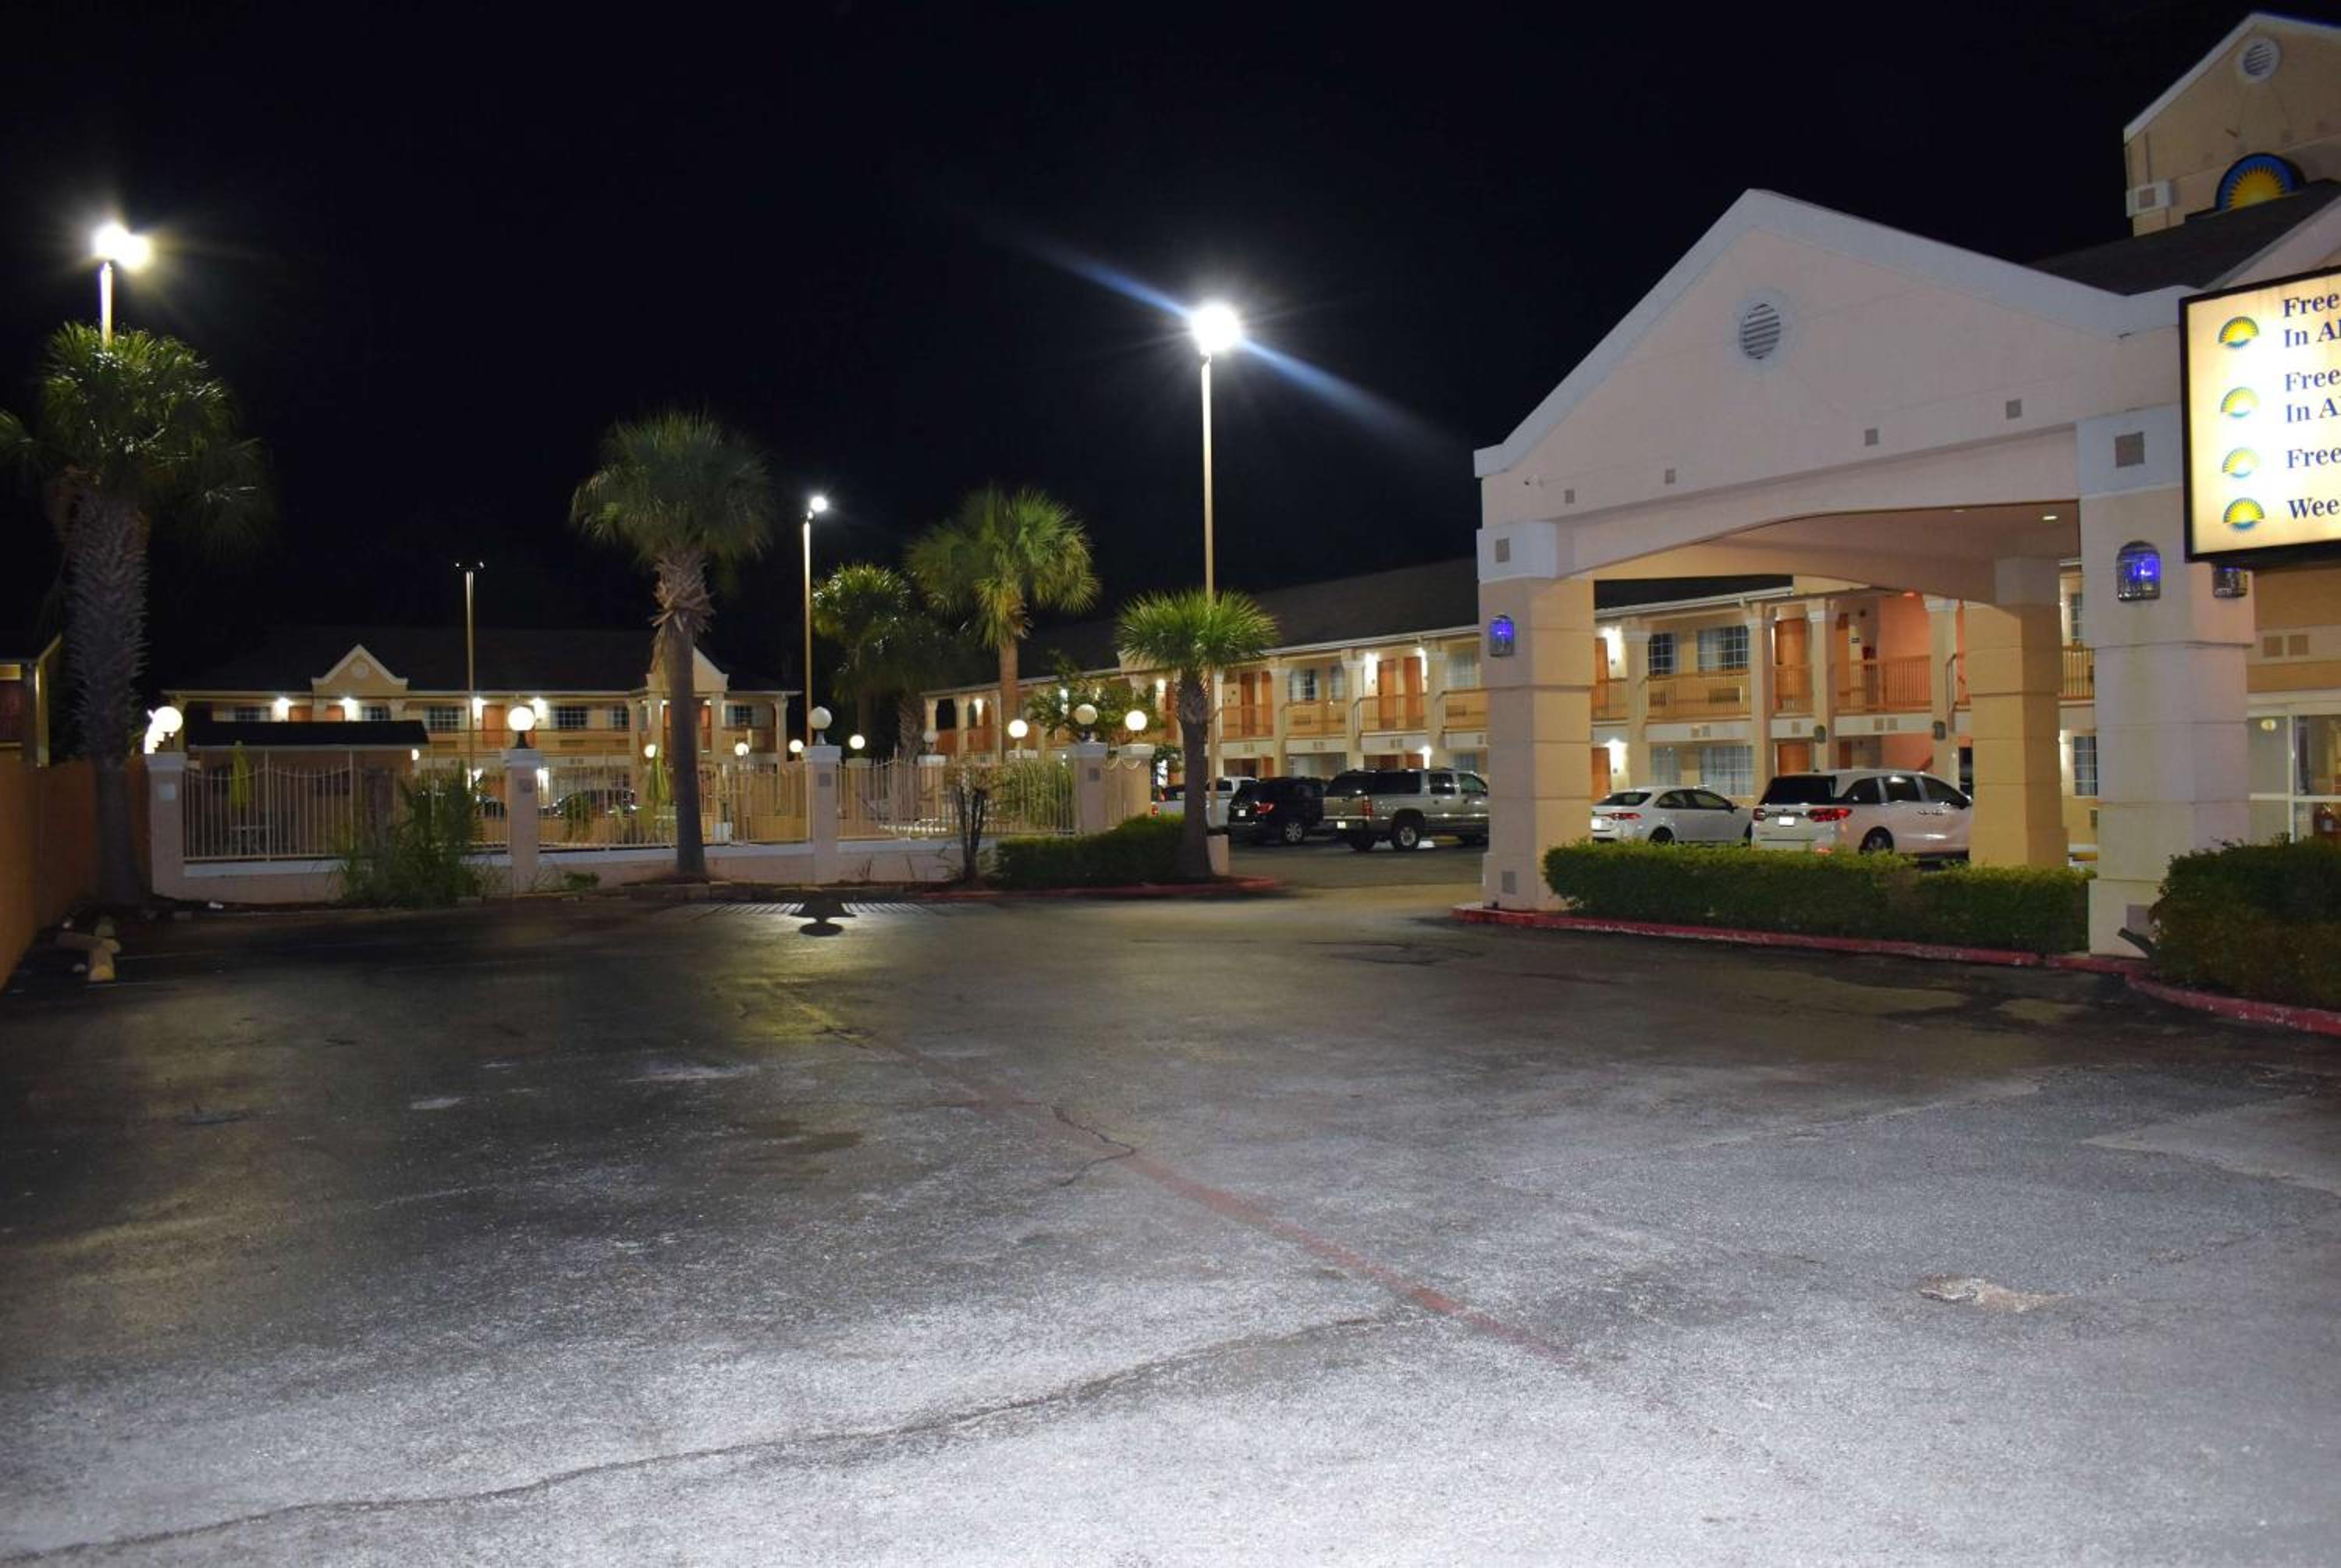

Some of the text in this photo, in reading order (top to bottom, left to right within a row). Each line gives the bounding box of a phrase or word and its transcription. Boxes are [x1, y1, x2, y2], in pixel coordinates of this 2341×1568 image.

[2283, 293, 2339, 318] Free
[2285, 328, 2308, 348] In
[2286, 369, 2341, 392] Free
[2287, 396, 2341, 423] In A
[2287, 447, 2341, 468] Free
[2287, 497, 2341, 520] Wee
